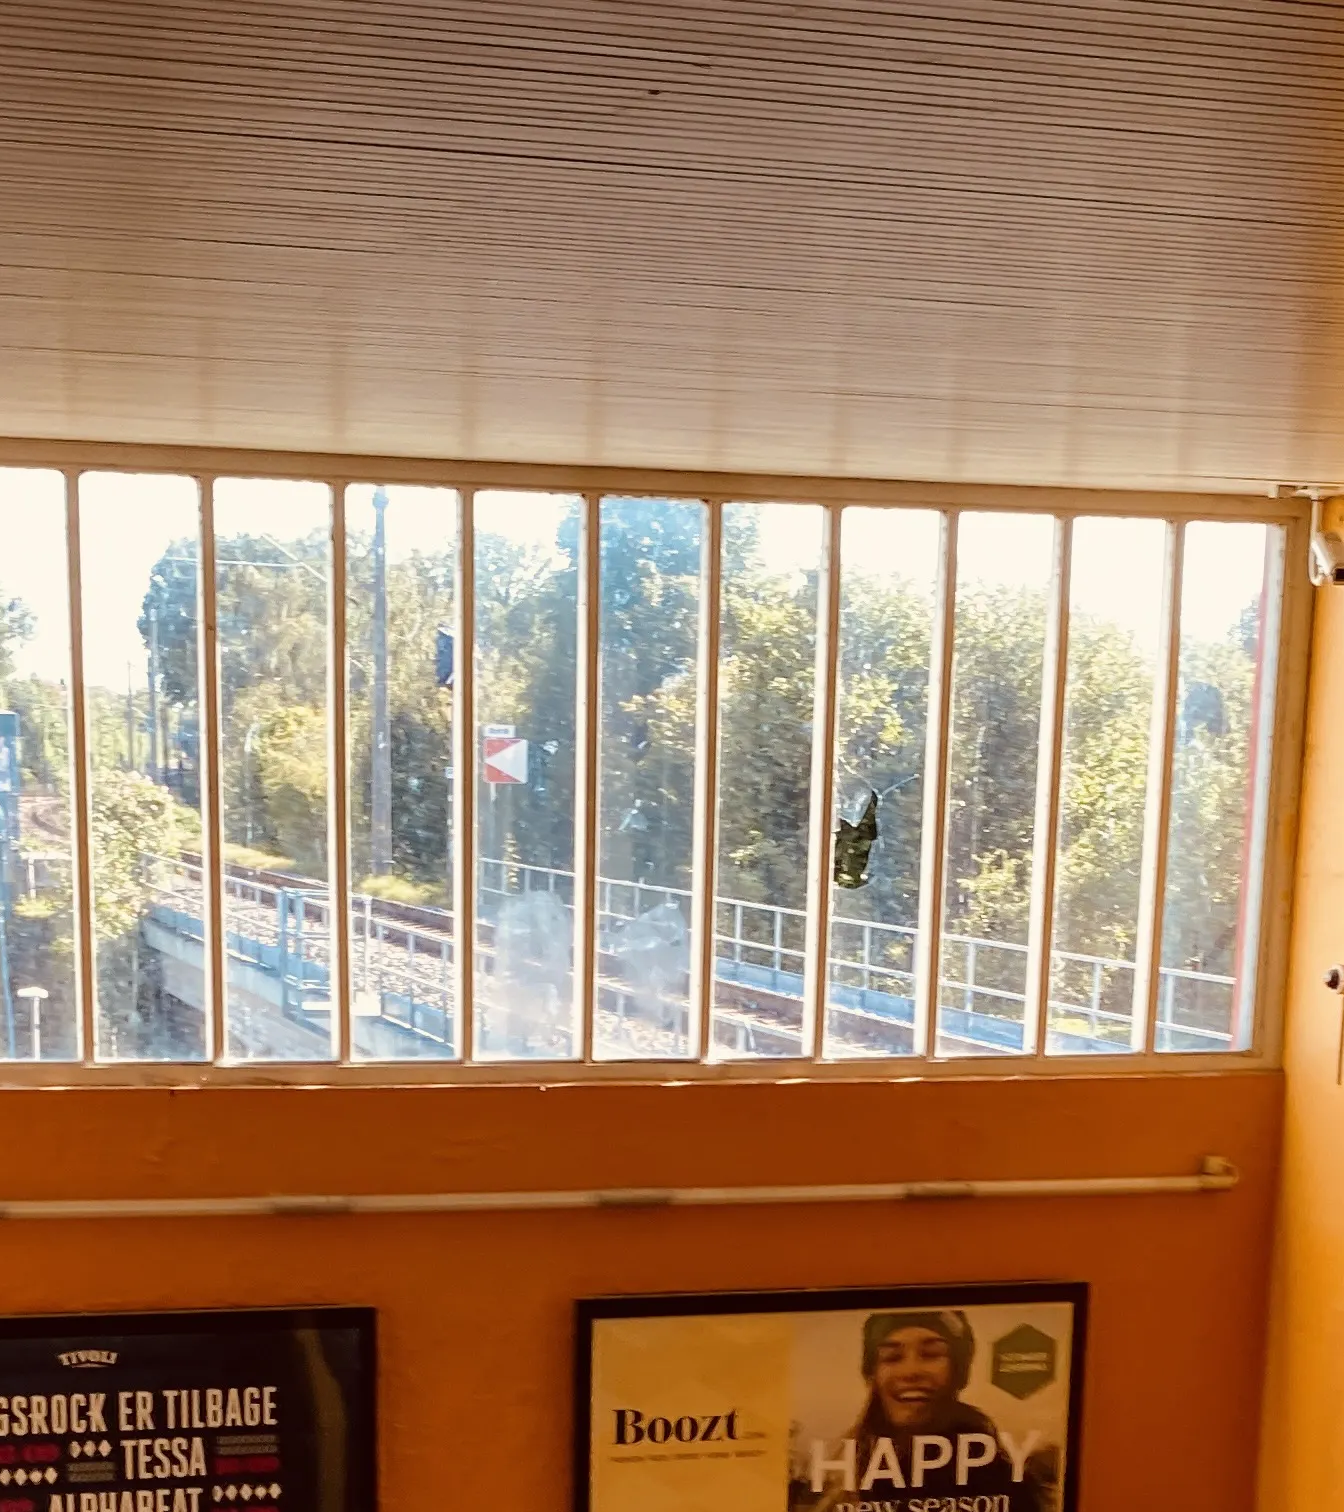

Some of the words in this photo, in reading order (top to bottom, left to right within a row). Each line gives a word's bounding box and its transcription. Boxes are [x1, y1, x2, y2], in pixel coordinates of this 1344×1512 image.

[118, 1390, 156, 1432] ER
[163, 1386, 278, 1429] TILBAGE
[612, 1407, 739, 1445] Boozt
[120, 1436, 207, 1480] TESSA
[809, 1429, 1042, 1493] HAPPY
